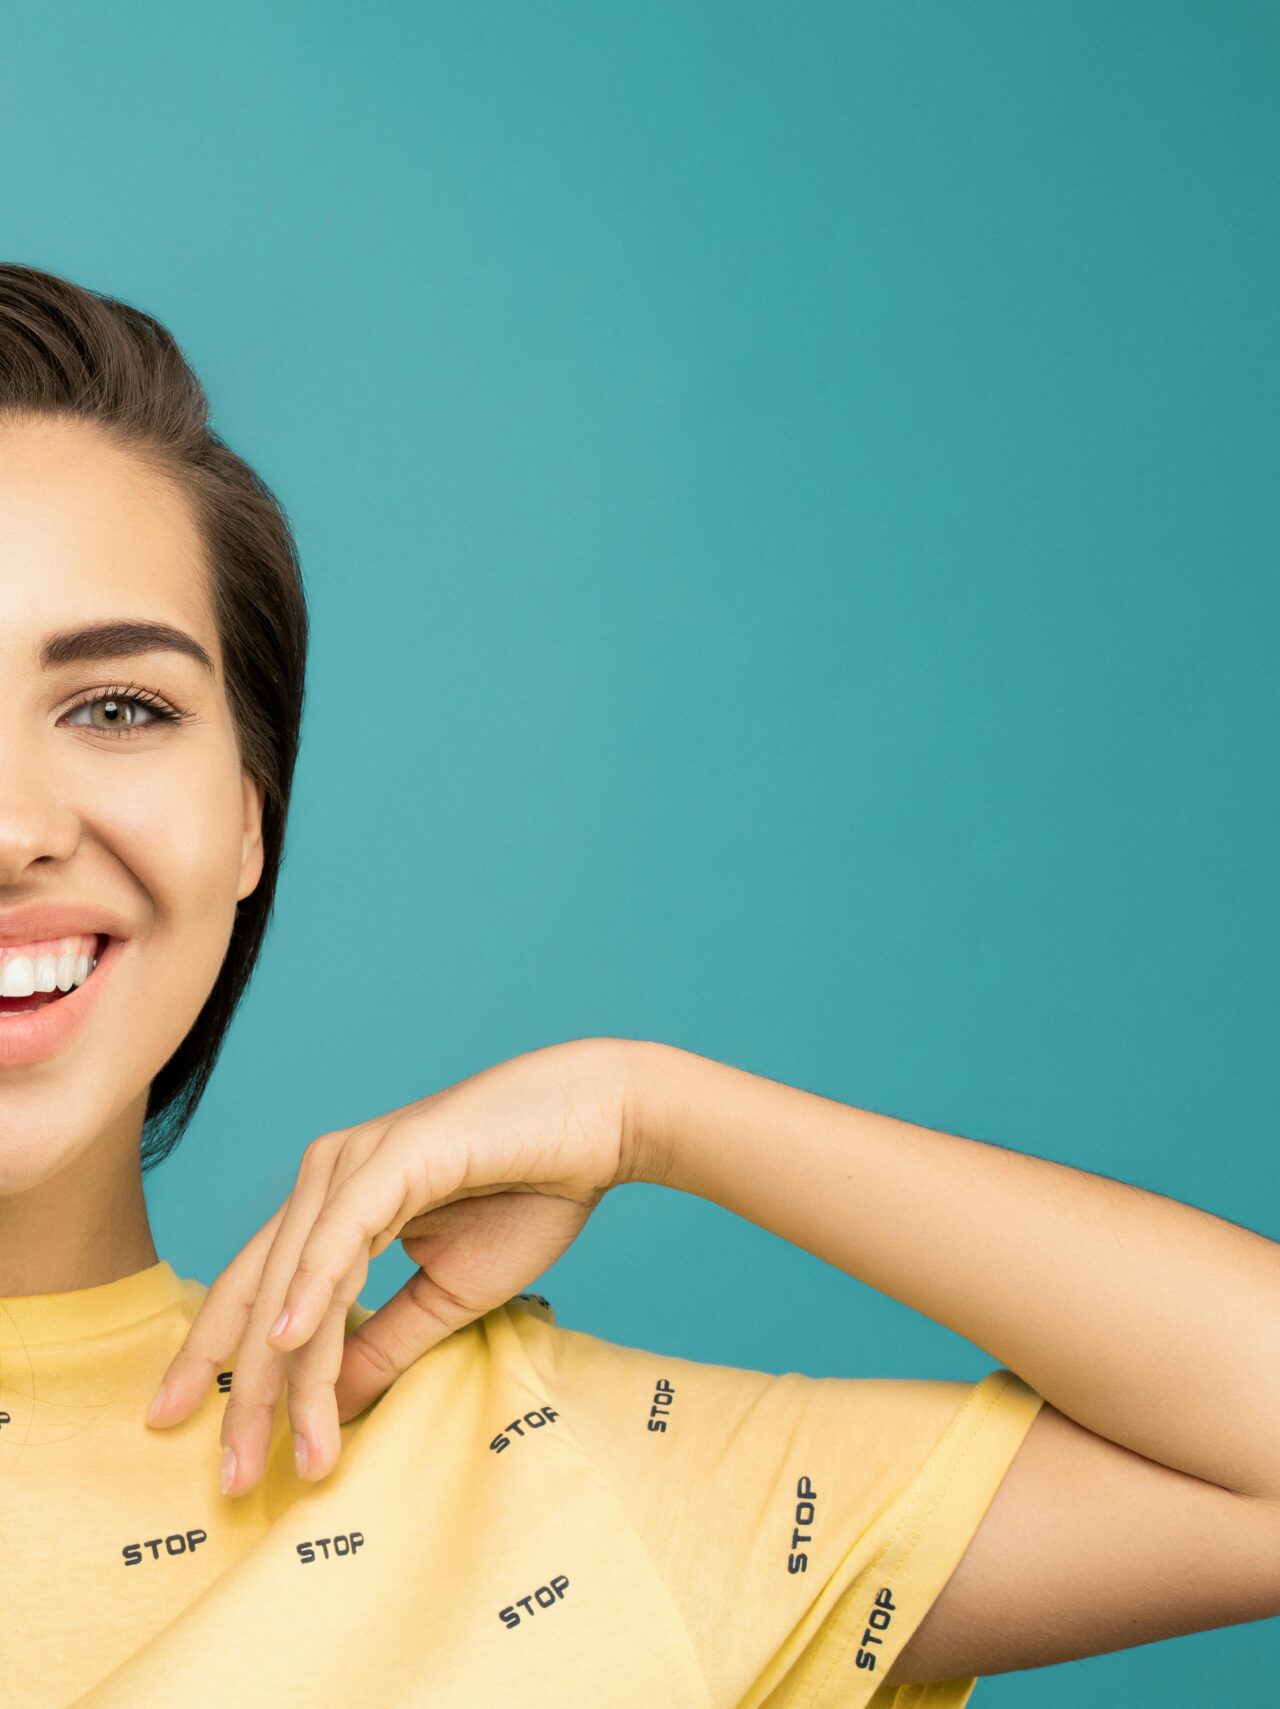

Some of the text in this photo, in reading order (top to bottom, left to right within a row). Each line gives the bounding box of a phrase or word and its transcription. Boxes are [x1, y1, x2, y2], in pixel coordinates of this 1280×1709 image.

[647, 1380, 675, 1433] STOP
[122, 1529, 208, 1567] STOP
[296, 1532, 365, 1565] STOP
[787, 1476, 818, 1574] STOP
[498, 1575, 570, 1629] STOP
[855, 1587, 896, 1672] STOP
